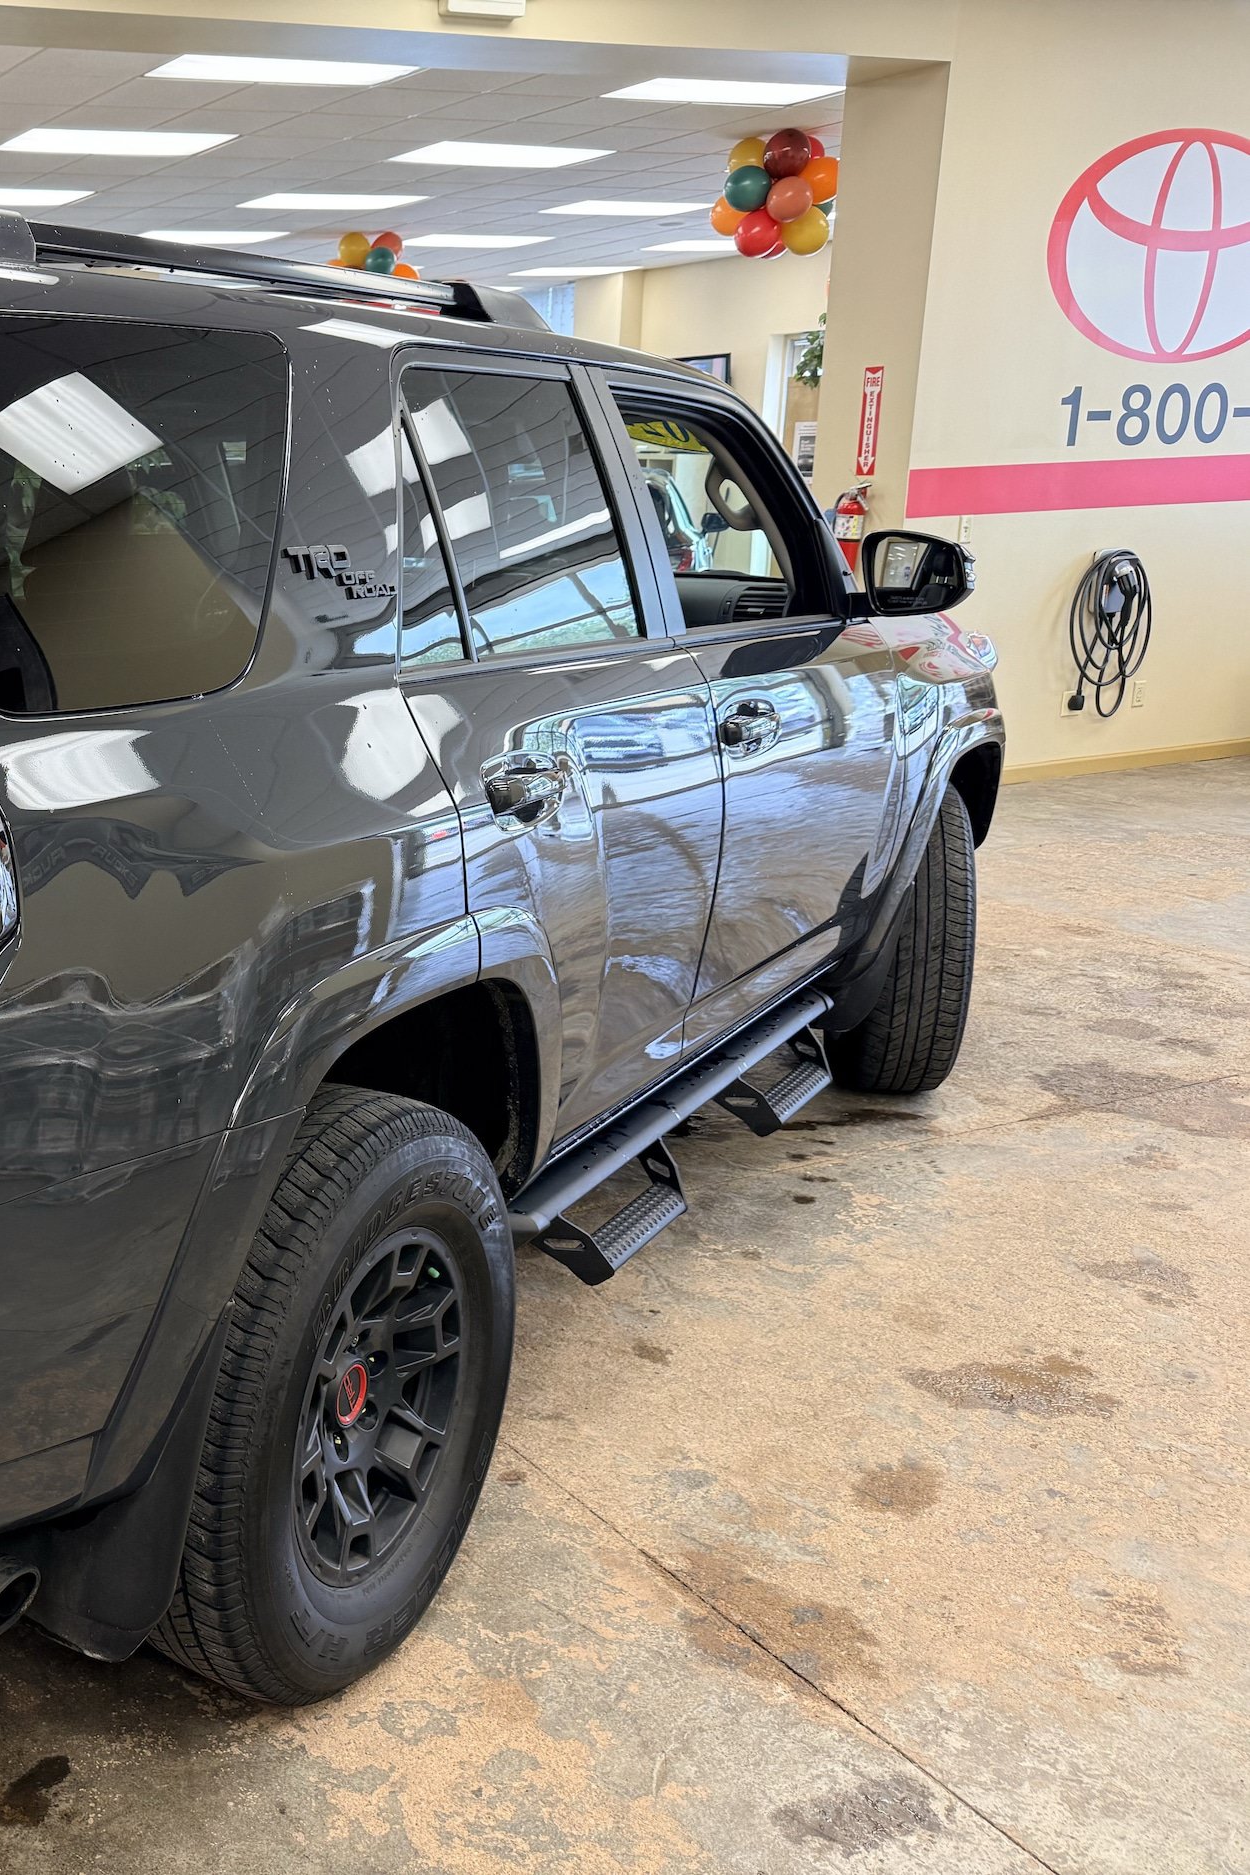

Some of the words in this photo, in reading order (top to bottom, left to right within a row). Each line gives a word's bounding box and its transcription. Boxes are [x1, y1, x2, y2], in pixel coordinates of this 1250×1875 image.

[866, 376, 881, 388] FIRE
[862, 390, 876, 468] EXTINGUISHER
[1061, 382, 1250, 447] 1-800-
[281, 545, 350, 580] TRD
[337, 570, 375, 587] OFF
[346, 583, 398, 600] ROAD
[312, 1168, 498, 1339] BRIDGESTONE
